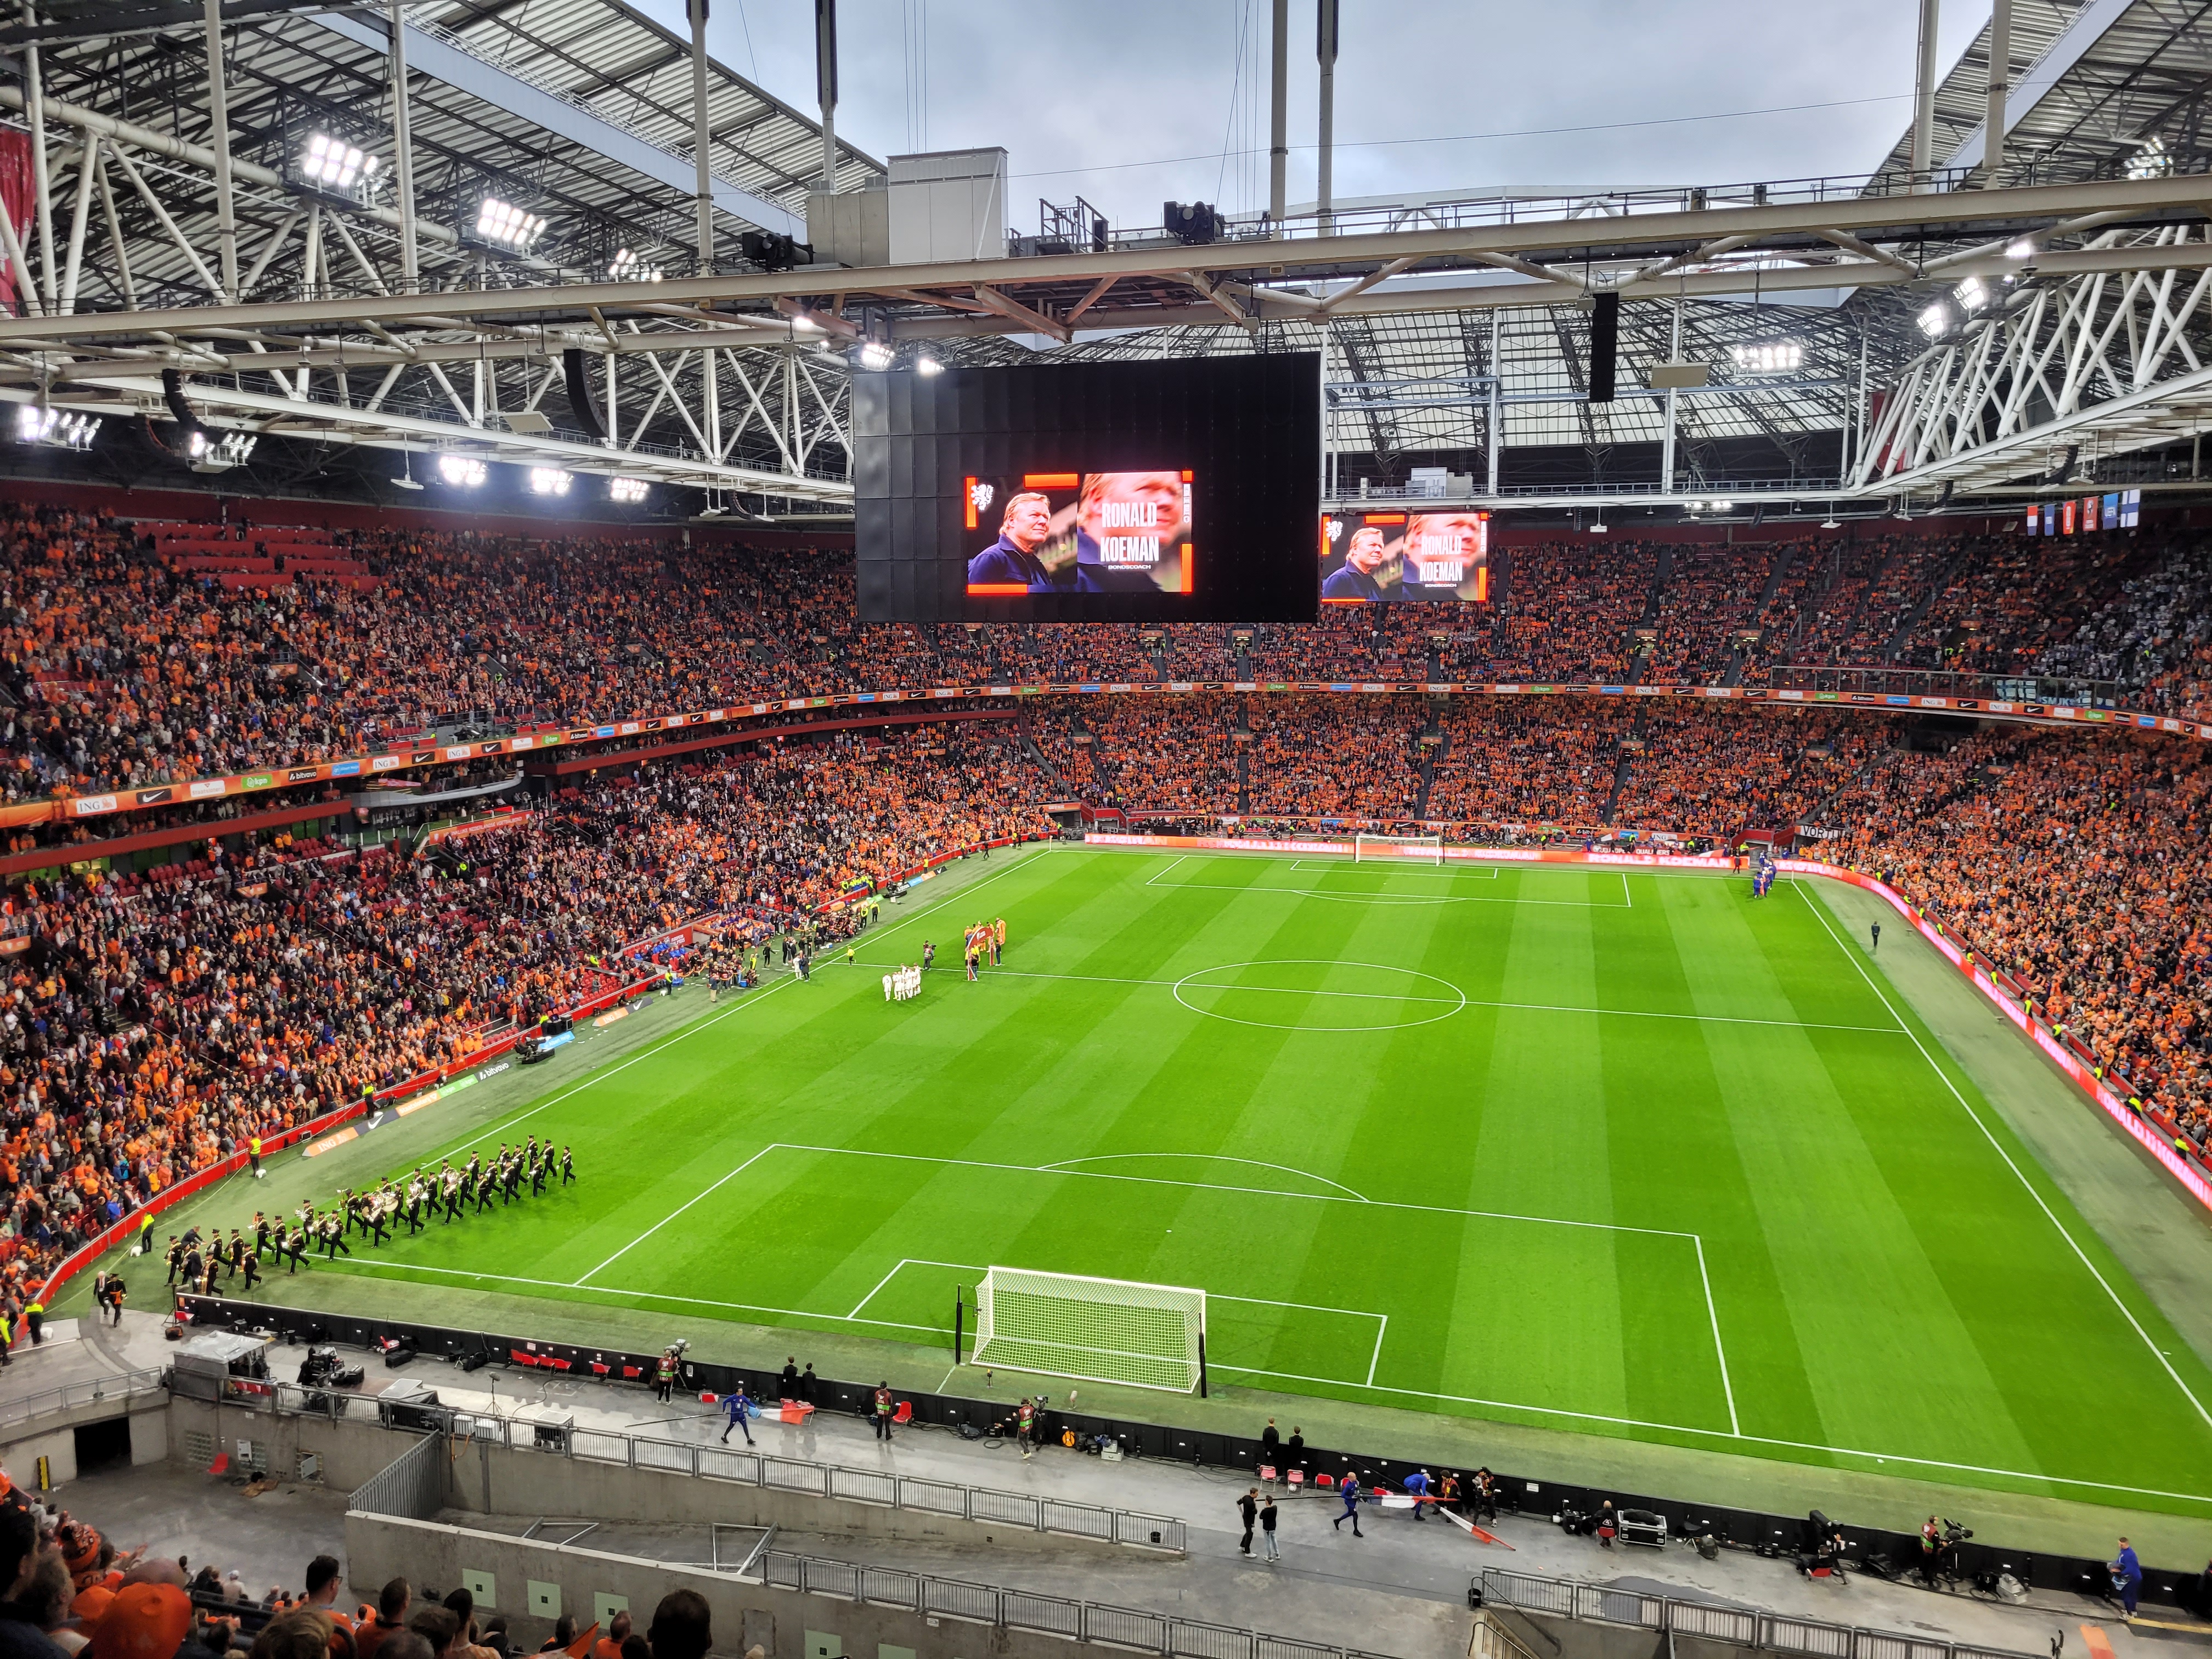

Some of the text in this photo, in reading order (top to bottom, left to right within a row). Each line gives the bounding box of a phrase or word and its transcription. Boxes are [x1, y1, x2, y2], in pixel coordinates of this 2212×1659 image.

[1102, 502, 1157, 527] RONALD
[1100, 536, 1159, 562] KOEMAN
[1421, 535, 1462, 555] RONALD
[1419, 561, 1463, 582] KOEMAN
[375, 760, 388, 769] ING
[296, 770, 317, 780] bitvavo
[255, 777, 268, 787] kpn
[192, 786, 224, 795] Staatsloterij
[79, 800, 100, 812] ING
[1589, 854, 1729, 867] RONALD KOEMAN
[603, 1015, 615, 1024] ING
[487, 1063, 509, 1077] bitvavo
[446, 1085, 455, 1093] kpn
[399, 1096, 432, 1114] Staatsloterij
[317, 1138, 336, 1153] ING
